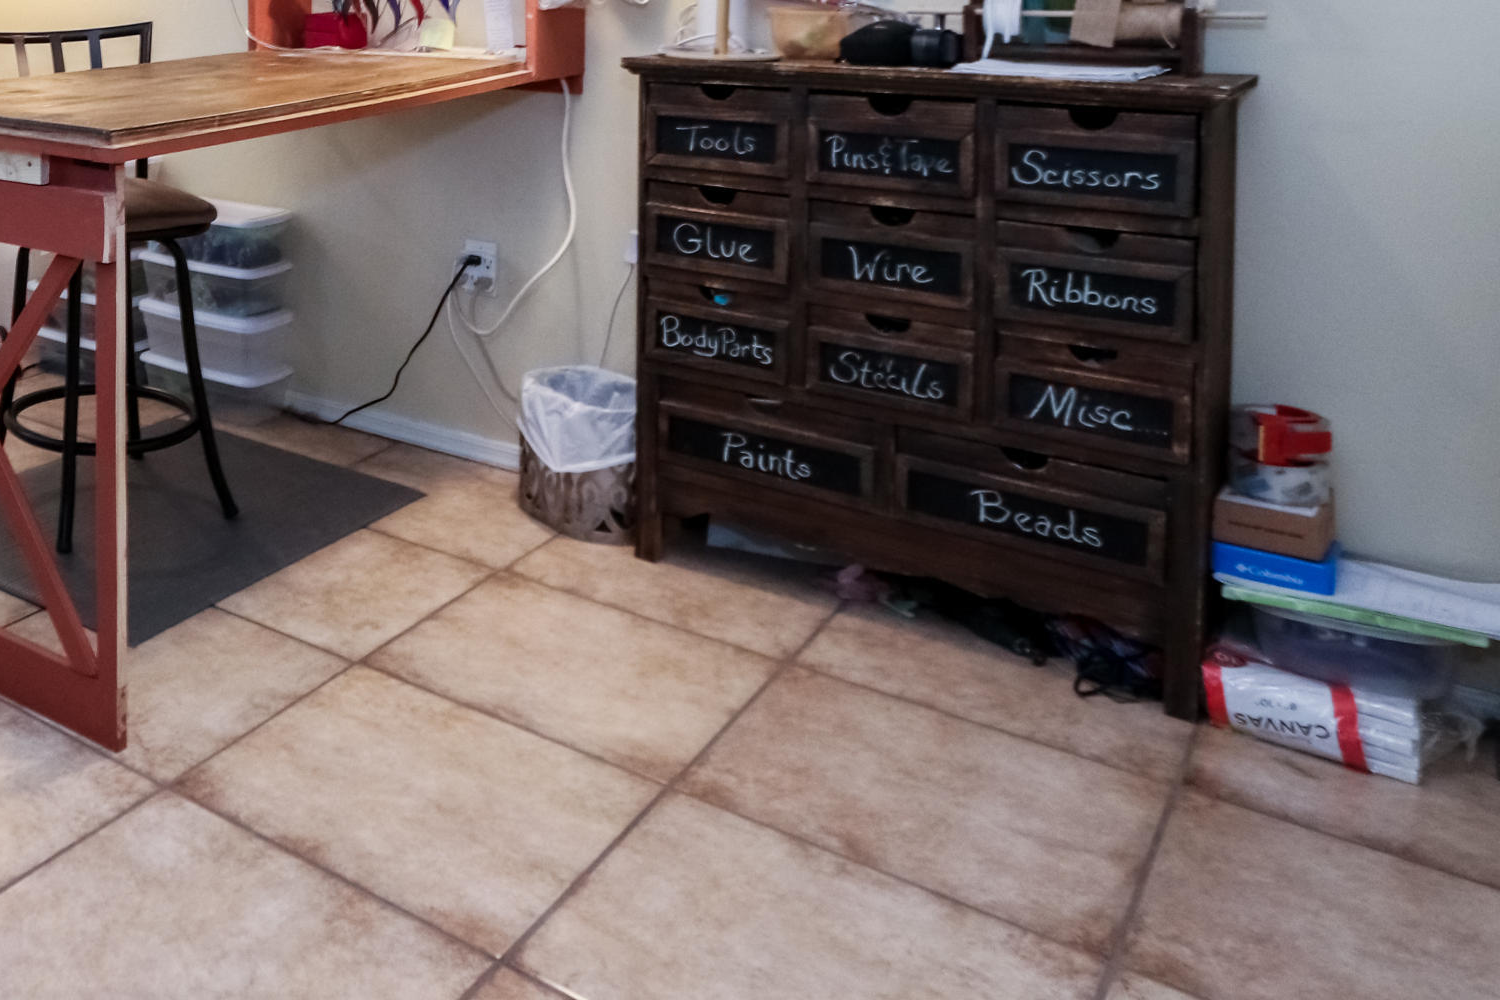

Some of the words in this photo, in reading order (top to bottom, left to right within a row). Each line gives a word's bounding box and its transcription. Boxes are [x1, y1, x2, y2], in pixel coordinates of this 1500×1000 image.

[675, 125, 757, 155] Tools
[1011, 149, 1162, 190] Scissors
[673, 222, 759, 262] Glue
[847, 245, 935, 284] Wire
[1020, 268, 1158, 315] Ribbons
[721, 432, 812, 481] Paints
[969, 489, 1102, 548] Beads
[1233, 711, 1331, 740] CANVAS
